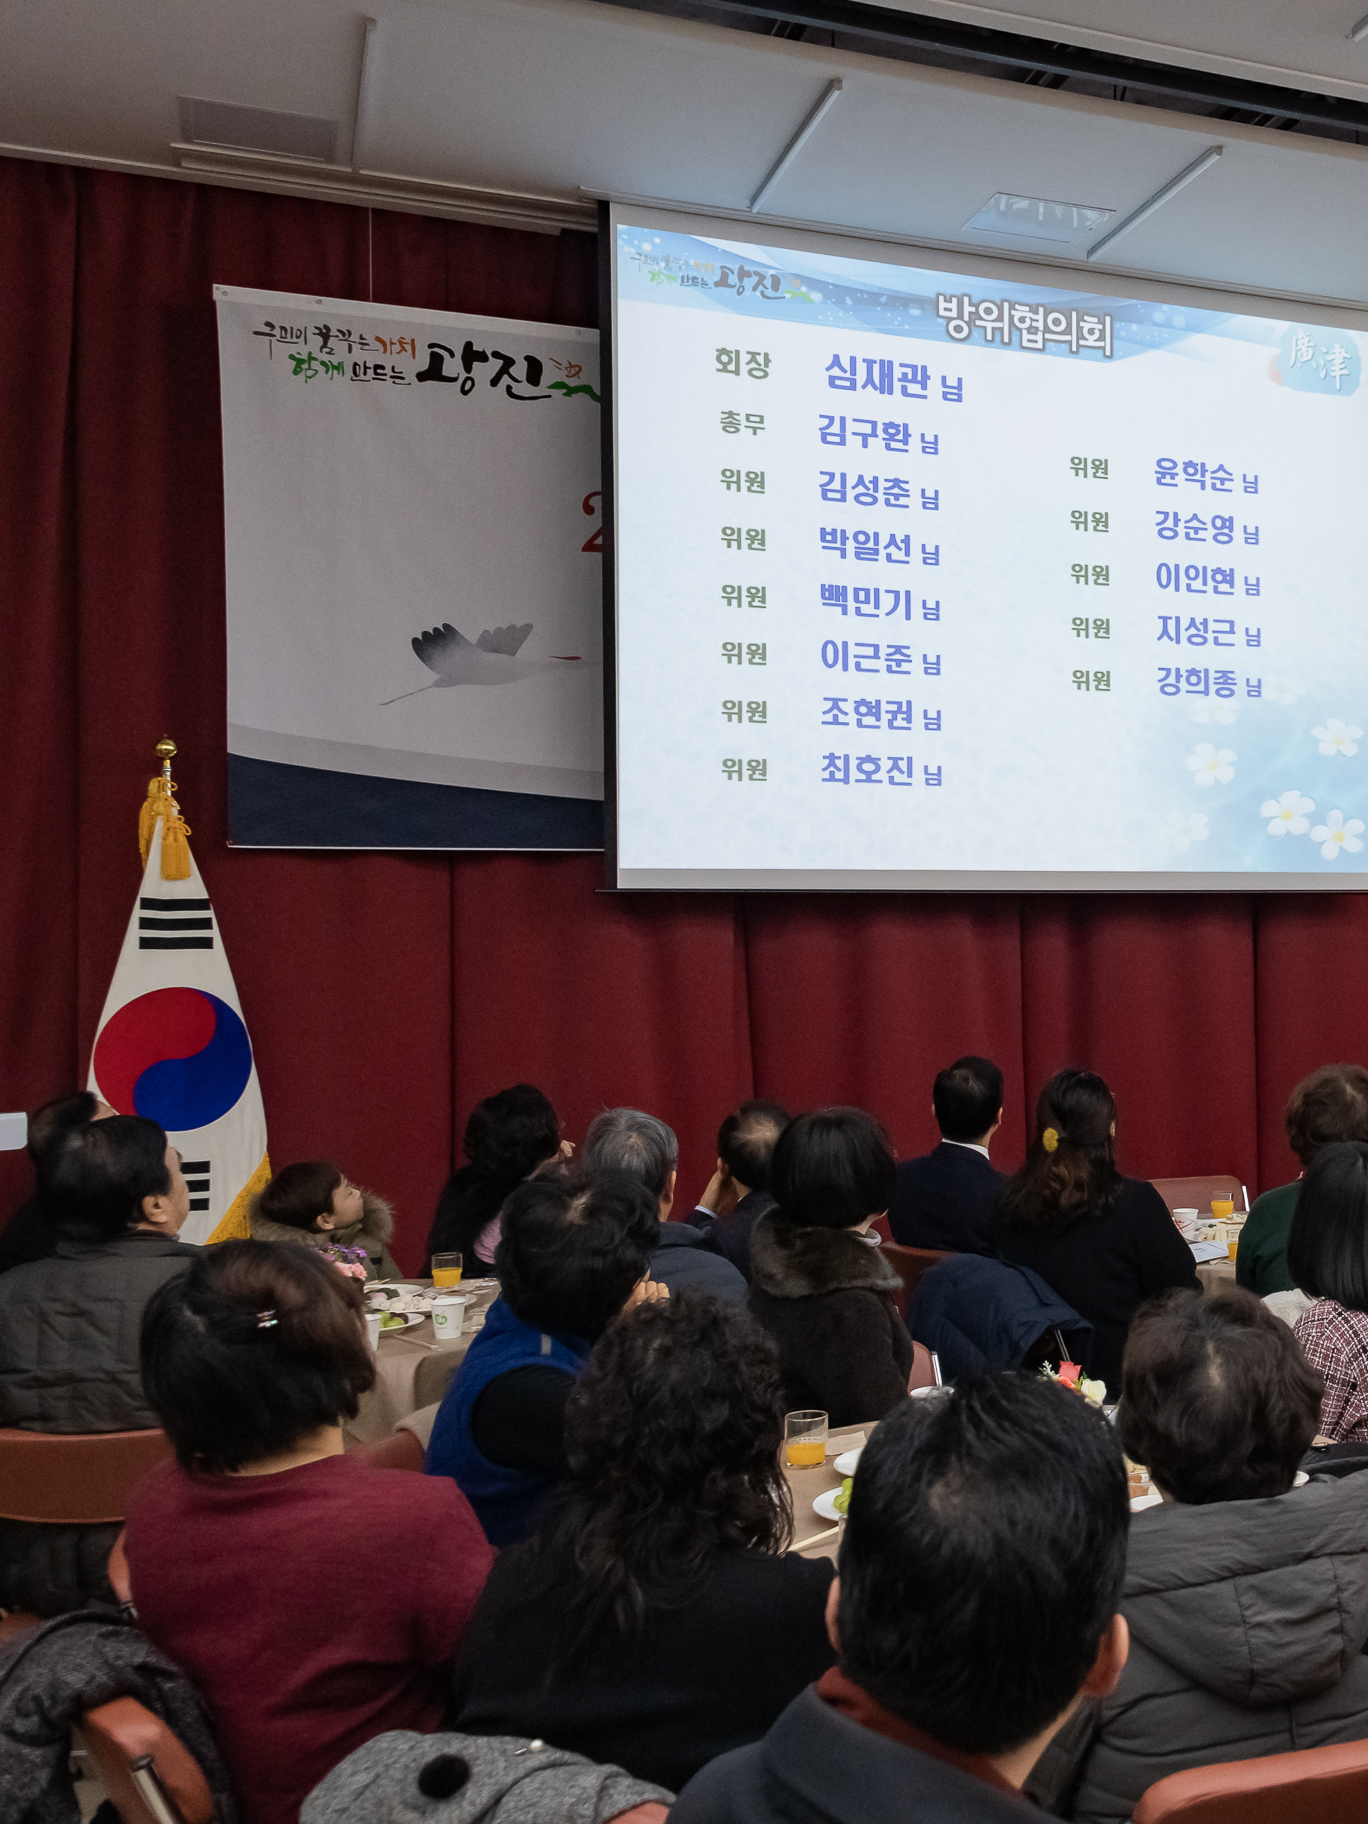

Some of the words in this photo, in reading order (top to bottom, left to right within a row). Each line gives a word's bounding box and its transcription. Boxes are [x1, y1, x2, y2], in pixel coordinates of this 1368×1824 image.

[714, 264, 785, 300] 광진
[312, 323, 379, 356] 꿈꾸는
[374, 335, 417, 360] 가치
[936, 293, 1114, 359] 방위협의회
[288, 350, 346, 385] 함께
[351, 359, 412, 386] 만드는
[415, 340, 552, 401] 광진
[715, 347, 772, 380] 회장
[825, 354, 931, 400] 심재관
[941, 375, 963, 403] 님
[720, 410, 765, 436] 총무
[818, 414, 912, 453] 김구환
[920, 433, 939, 455] 님
[720, 468, 765, 494] 위원
[819, 471, 910, 509] 김성춘
[921, 488, 939, 511] 님
[1070, 456, 1108, 479] 위원
[1155, 458, 1234, 492] 윤학순
[1243, 474, 1258, 494] 님
[721, 526, 766, 551] 위원
[820, 527, 910, 564] 박일선
[921, 544, 939, 566] 님
[1070, 510, 1109, 533] 위원
[1155, 511, 1234, 545] 강순영
[1243, 525, 1259, 545] 님
[1071, 564, 1109, 586] 위원
[1156, 563, 1235, 595] 이인현
[1244, 576, 1260, 596] 님
[721, 585, 766, 608] 위원
[821, 584, 911, 621] 백민기
[922, 599, 940, 621] 님
[1071, 617, 1110, 639] 위원
[1157, 616, 1236, 647] 지성근
[1245, 627, 1261, 647] 님
[722, 642, 767, 666] 위원
[821, 640, 912, 675] 이근준
[923, 654, 941, 676] 님
[1072, 670, 1111, 692] 위원
[1157, 667, 1237, 698] 강희종
[1246, 678, 1261, 698] 님
[722, 700, 767, 723] 위원
[821, 697, 912, 730] 조현권
[923, 709, 941, 731] 님
[722, 758, 767, 781] 위원
[821, 752, 913, 786] 최호진
[924, 765, 942, 787] 님
